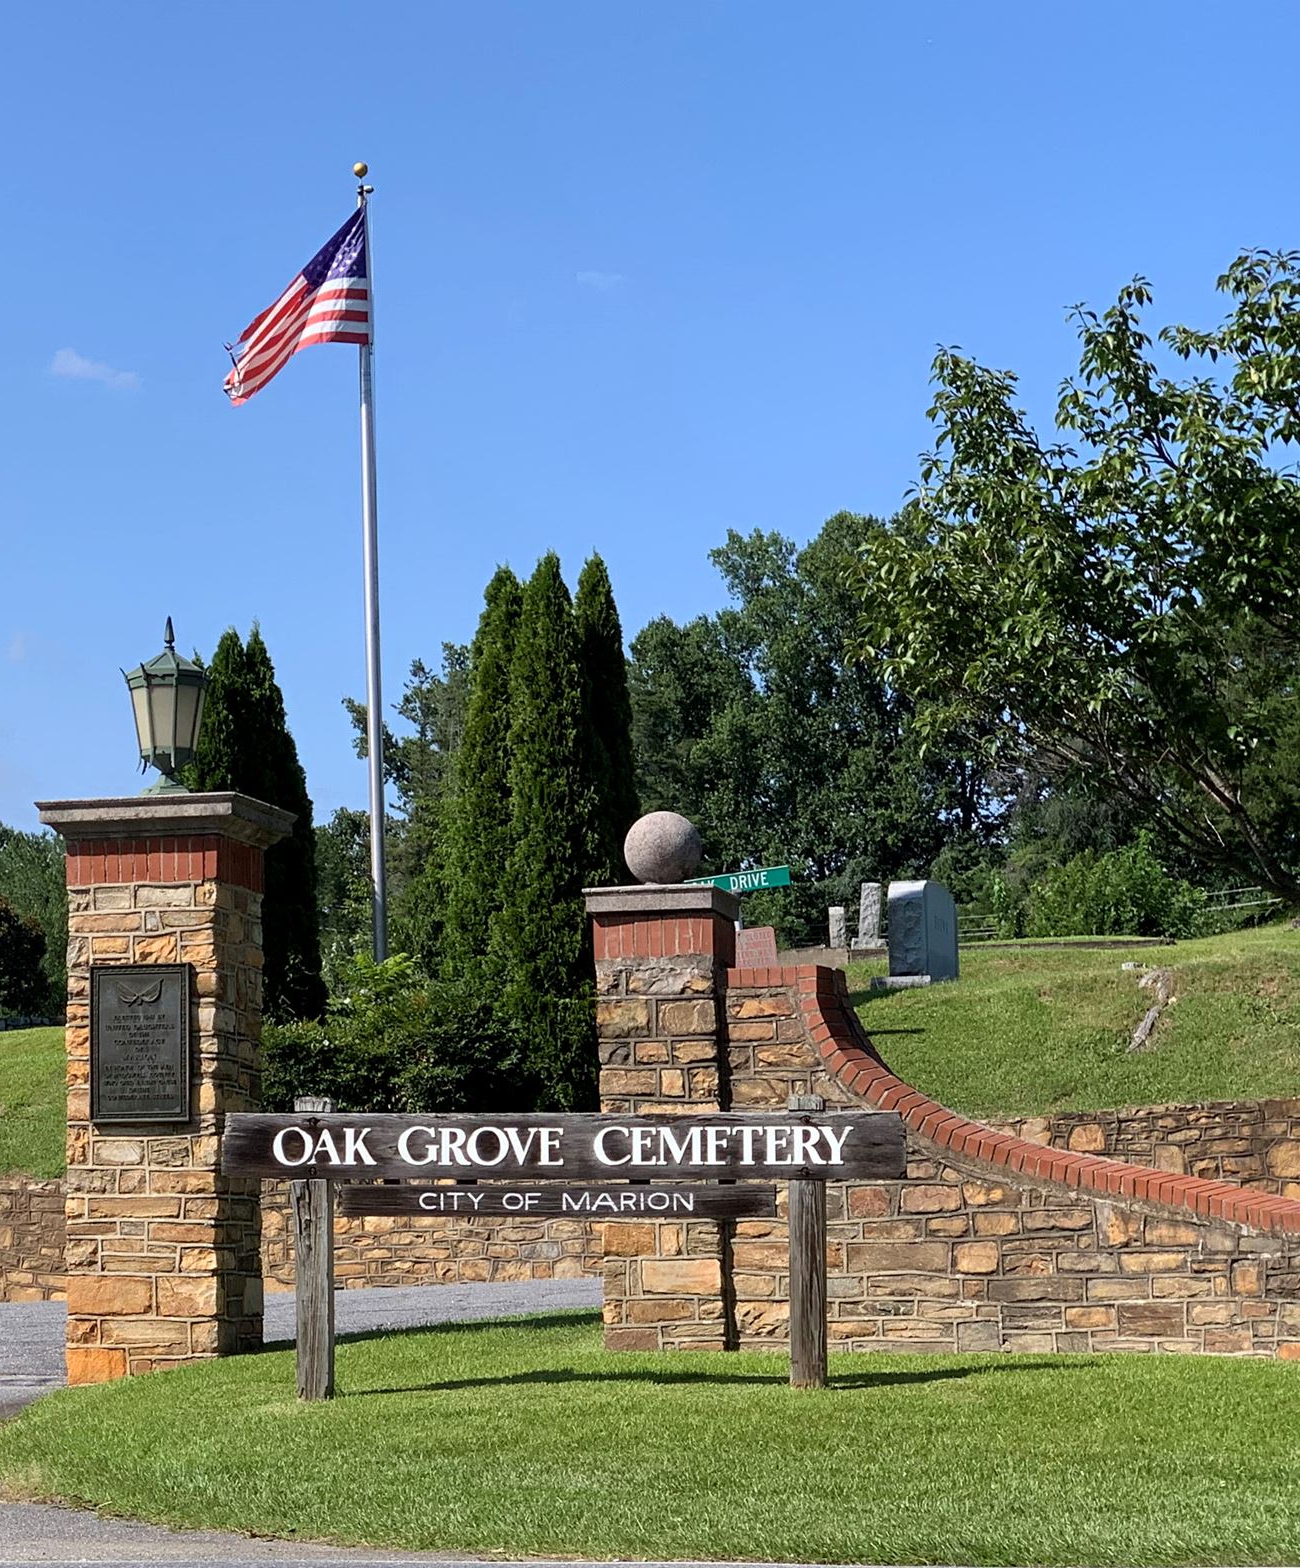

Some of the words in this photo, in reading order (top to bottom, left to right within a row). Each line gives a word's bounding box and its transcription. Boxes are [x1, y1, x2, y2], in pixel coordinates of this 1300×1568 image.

[729, 871, 769, 890] DRIVE
[272, 1125, 377, 1167] OAK
[397, 1125, 564, 1167] GROVE
[593, 1125, 854, 1166] CEMETERY
[418, 1192, 484, 1211] CITY
[502, 1192, 542, 1211] OF
[562, 1192, 694, 1211] MARION
